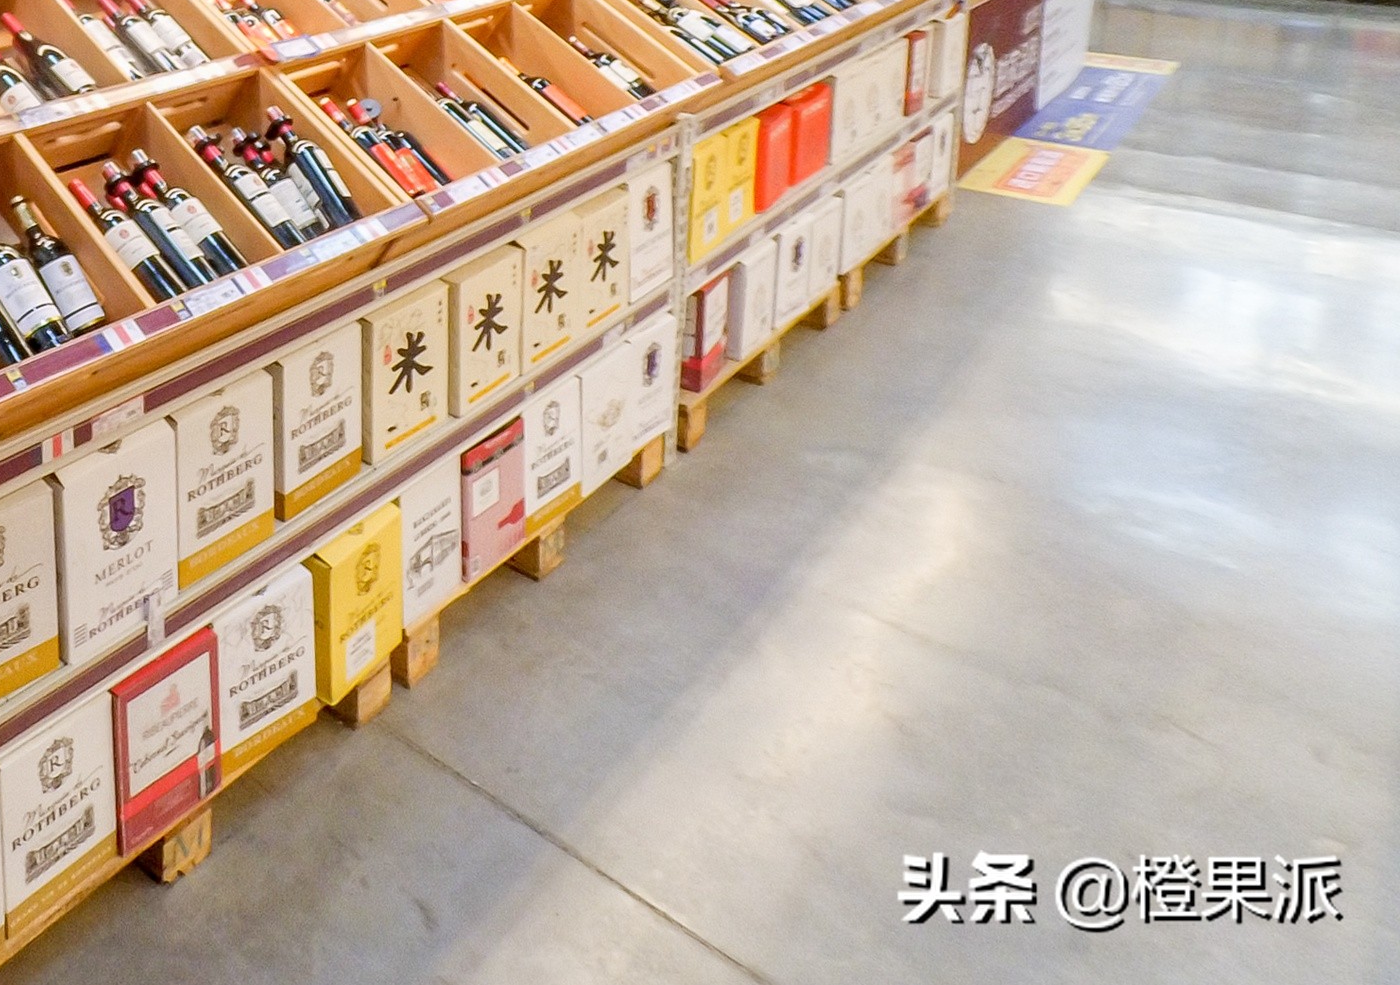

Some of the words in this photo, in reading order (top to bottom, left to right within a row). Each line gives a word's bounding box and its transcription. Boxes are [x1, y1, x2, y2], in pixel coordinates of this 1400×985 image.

[535, 259, 569, 314] 米
[472, 292, 509, 352] 米
[389, 330, 434, 395] 米
[290, 396, 354, 441] ROTHBERG
[186, 453, 264, 503] ROTHBERG
[93, 539, 154, 585] MERLOT
[229, 645, 307, 699] ROTHBERG
[49, 754, 63, 773] R
[11, 777, 102, 853] ROTHBERG
